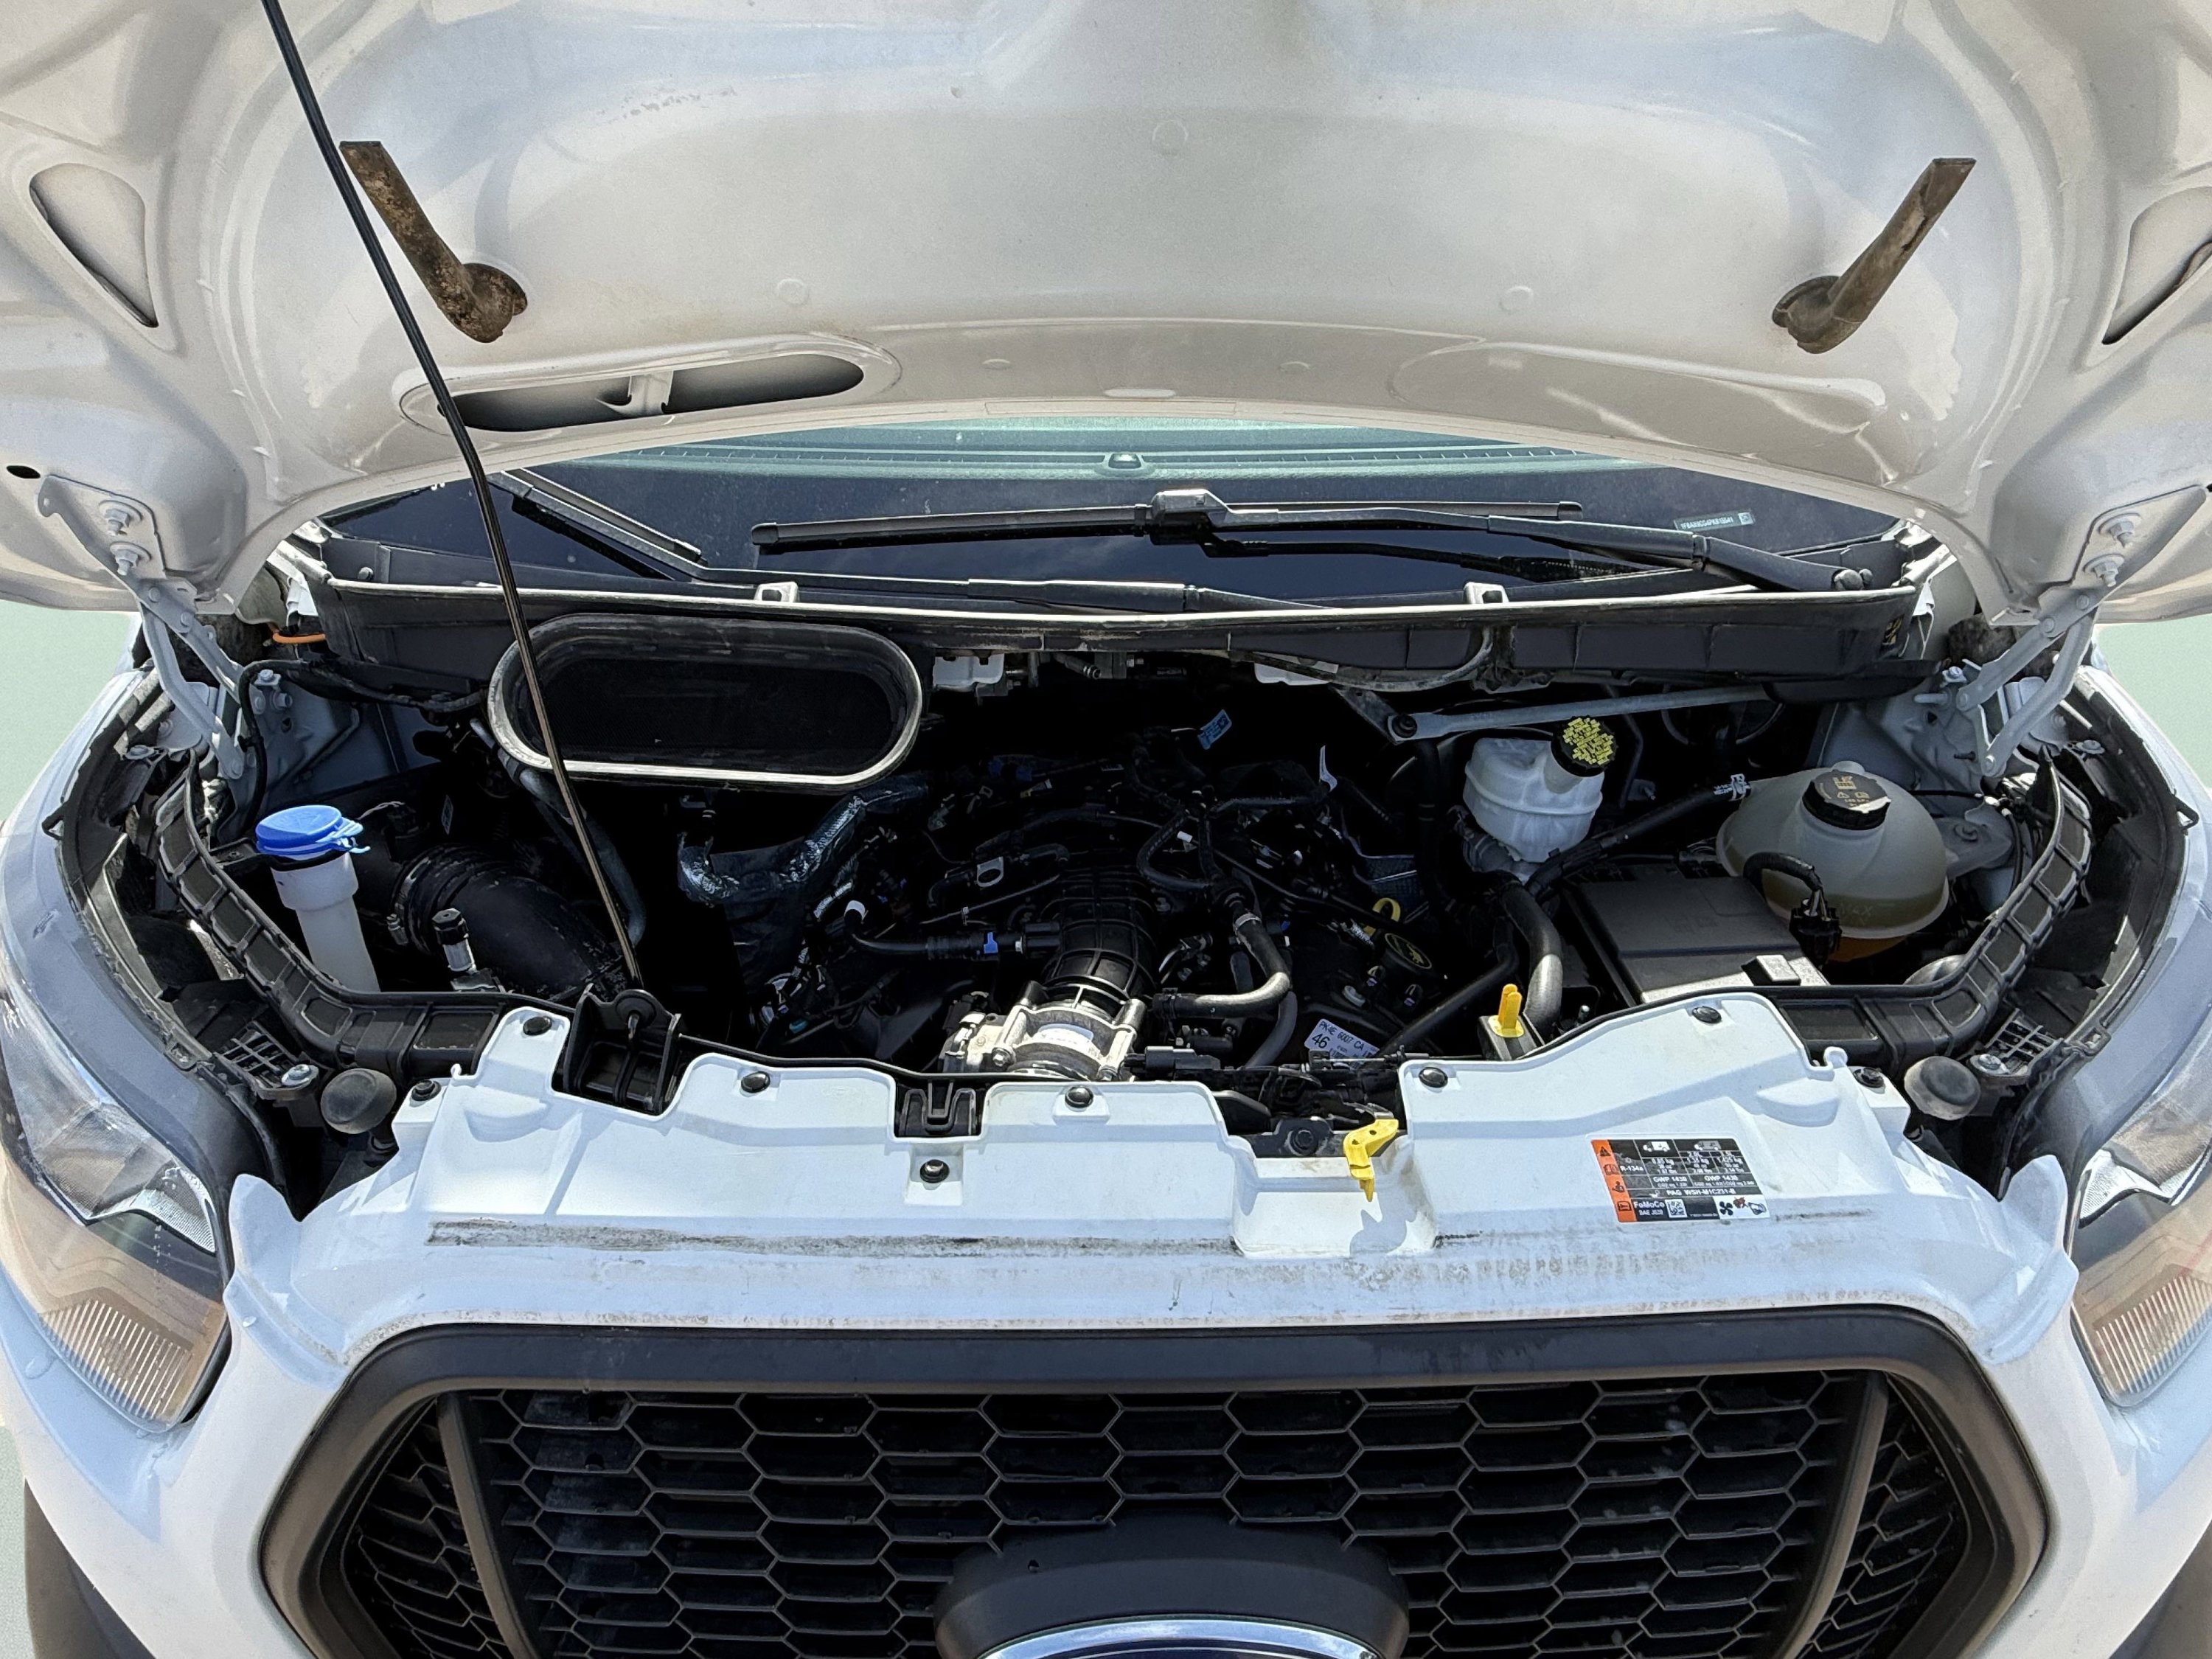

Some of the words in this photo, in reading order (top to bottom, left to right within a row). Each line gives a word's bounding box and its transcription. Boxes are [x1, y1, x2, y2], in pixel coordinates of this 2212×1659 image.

[1312, 1033, 1330, 1049] 46
[1337, 1032, 1354, 1044] 6007
[1354, 1040, 1365, 1051] CA
[1632, 1200, 1666, 1208] FoMoCo
